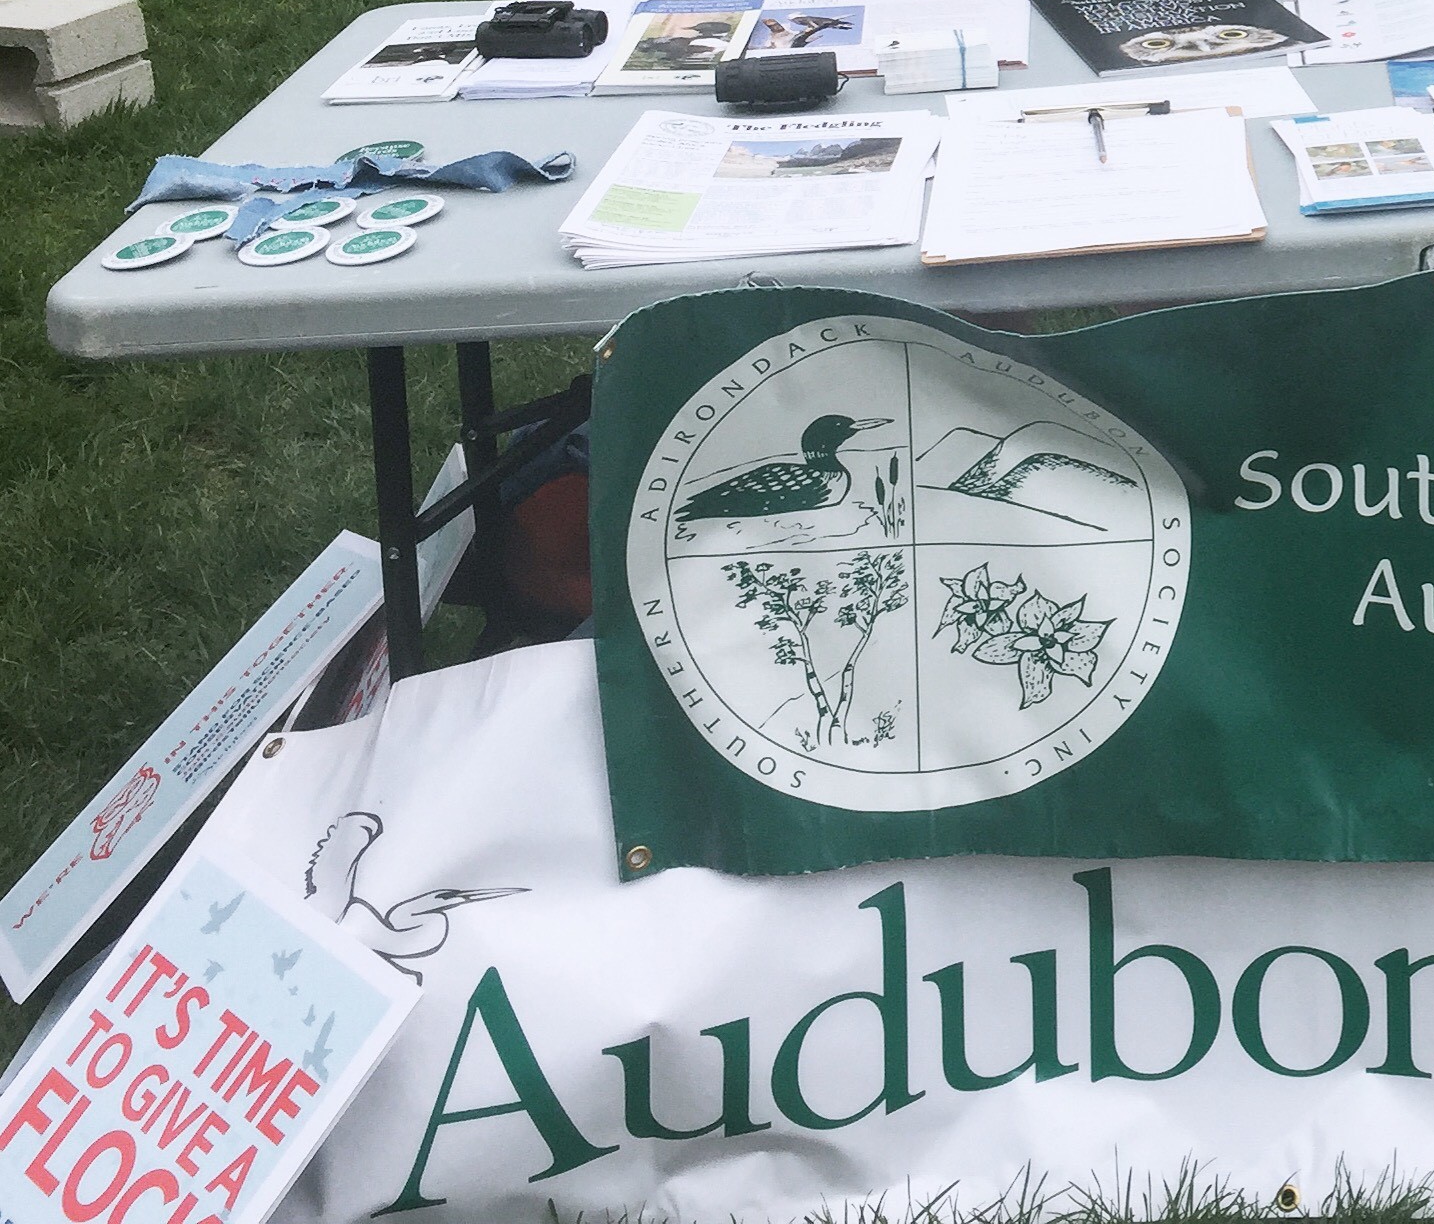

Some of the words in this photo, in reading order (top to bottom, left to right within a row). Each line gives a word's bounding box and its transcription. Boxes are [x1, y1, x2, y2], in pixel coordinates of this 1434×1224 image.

[640, 321, 871, 523] ADIRONDACK
[959, 351, 1150, 456] AUDUBON
[647, 598, 807, 790] SOUTHERN
[1113, 516, 1182, 711] SOCIETY
[12, 851, 82, 934] WE'RE
[163, 737, 187, 766] IN
[191, 684, 236, 735] THIS
[1002, 728, 1093, 778] INC.
[66, 1009, 133, 1089] TO
[122, 1064, 231, 1177] GIVE
[205, 1145, 258, 1211] A
[106, 944, 210, 1049] IT'S
[193, 1009, 320, 1146] TIME
